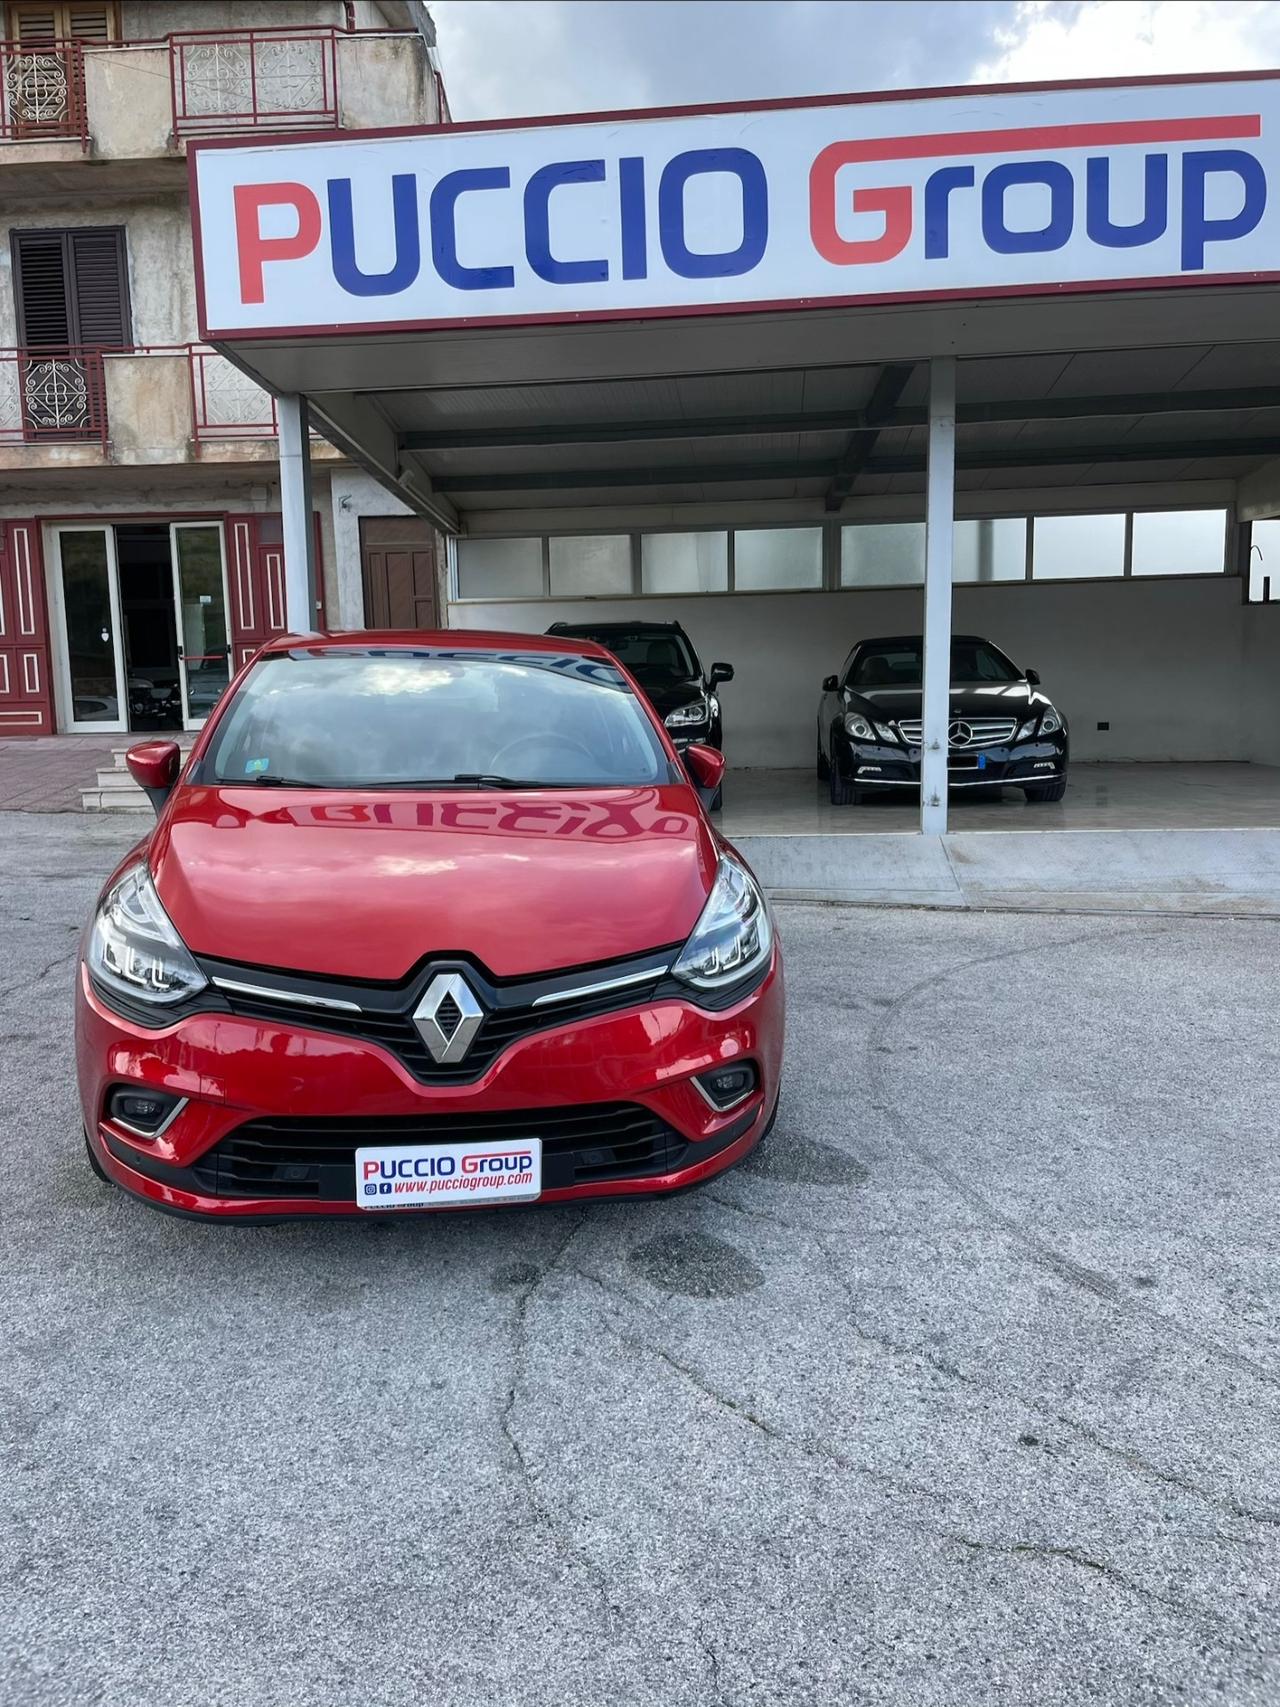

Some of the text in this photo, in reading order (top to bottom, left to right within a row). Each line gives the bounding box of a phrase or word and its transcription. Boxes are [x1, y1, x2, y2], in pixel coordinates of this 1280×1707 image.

[233, 147, 769, 304] PUCCIO
[363, 1156, 455, 1180] PUCCIO
[394, 1172, 533, 1194] www.pucciogroup.com
